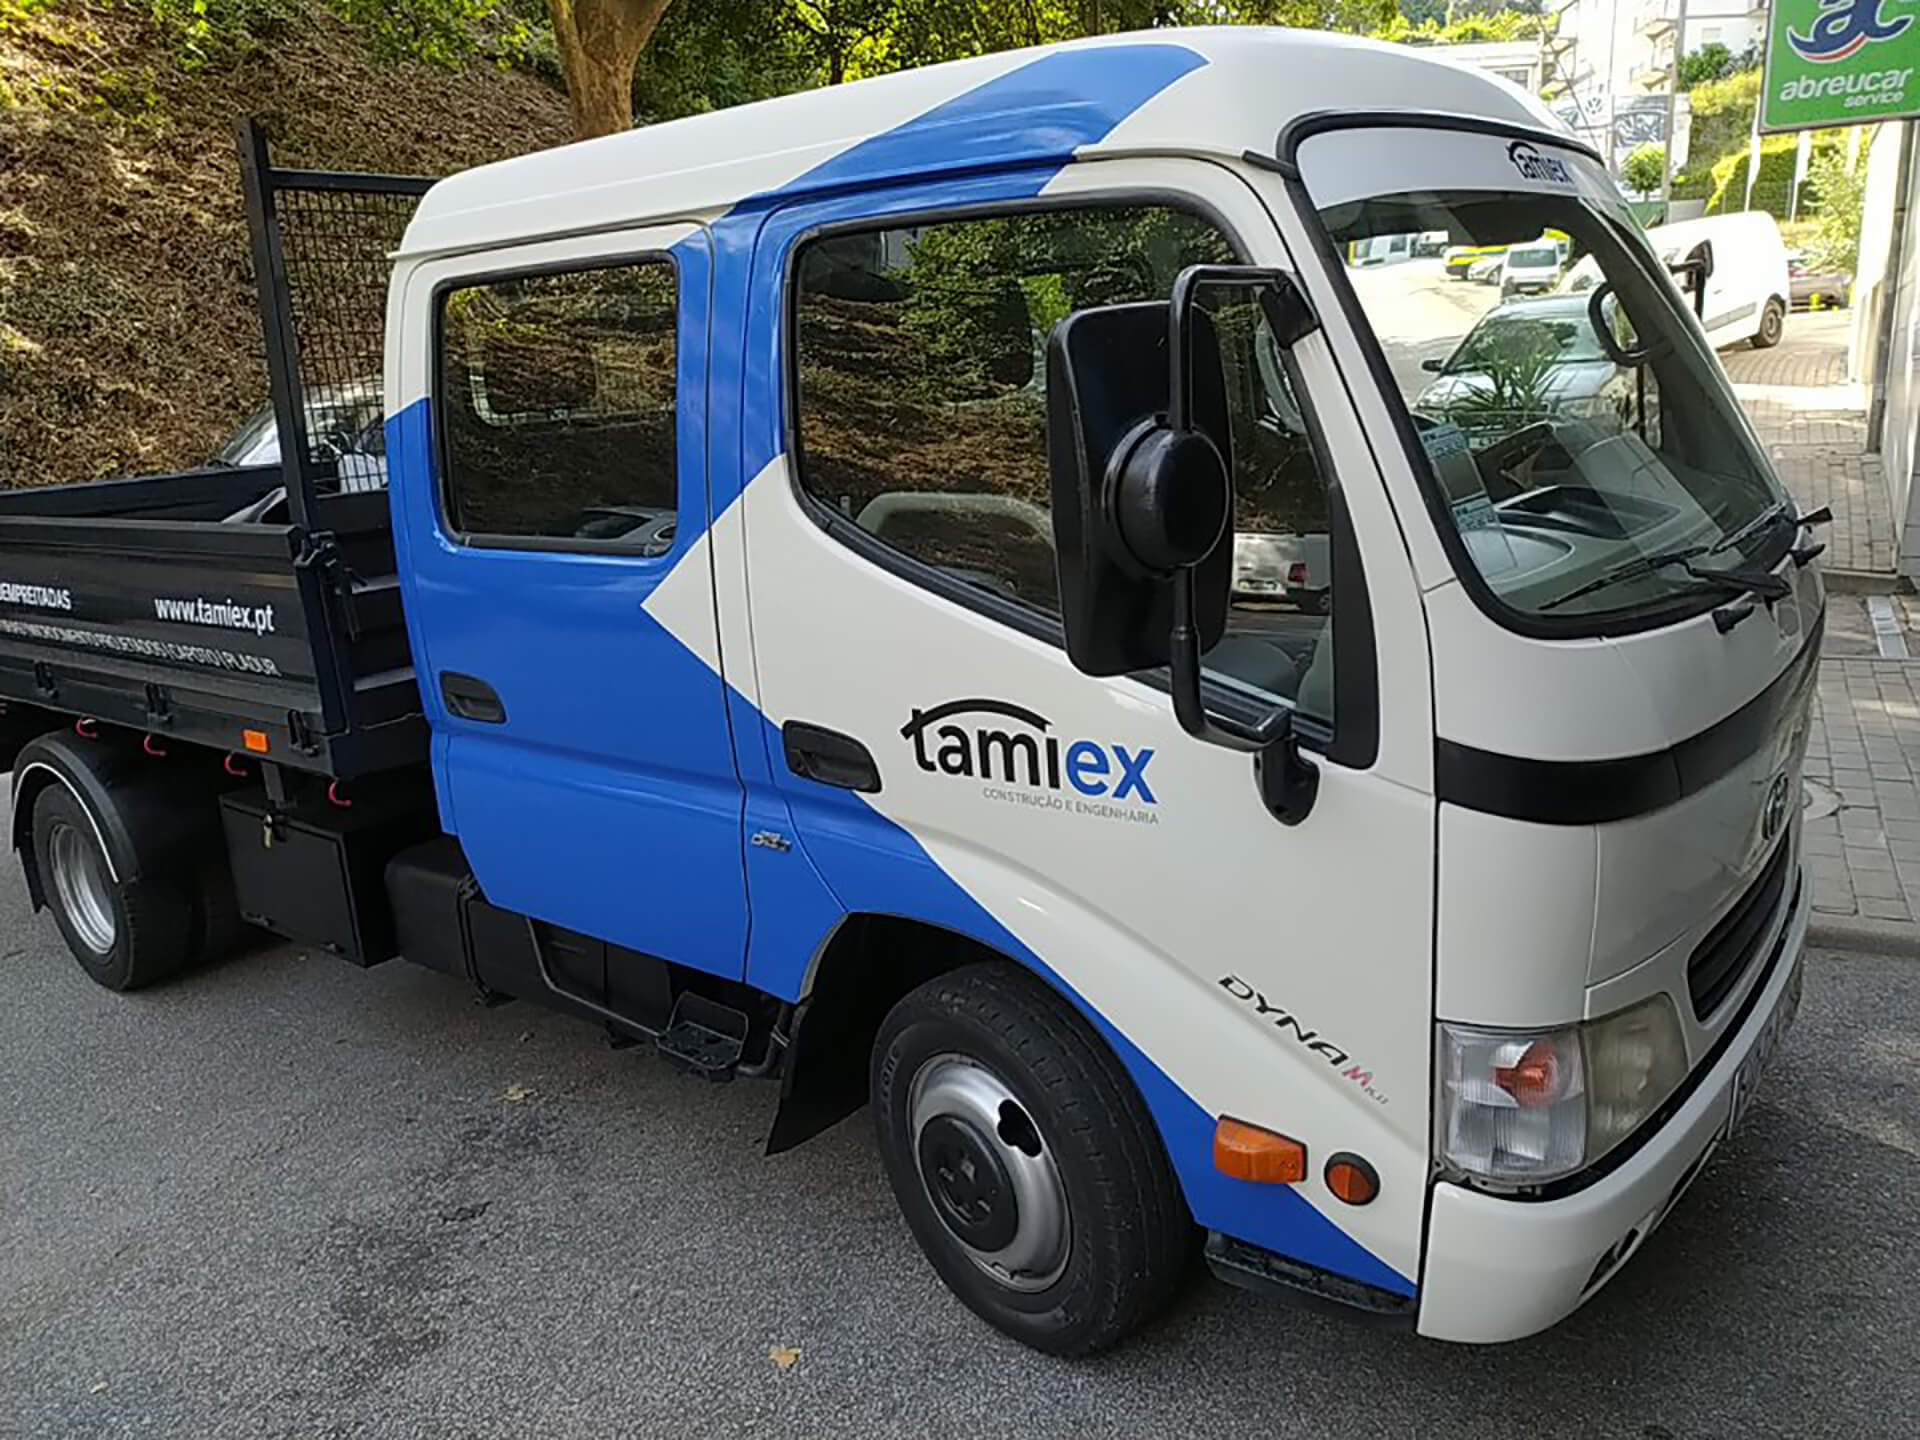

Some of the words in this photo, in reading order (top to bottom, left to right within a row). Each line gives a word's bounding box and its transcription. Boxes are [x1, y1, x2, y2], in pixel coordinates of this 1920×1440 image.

[1780, 68, 1914, 101] abreucar
[1843, 91, 1904, 108] service
[155, 598, 275, 636] www.tamiex.pt
[900, 699, 1158, 804] tamiex
[983, 787, 1063, 810] CONSTRUÇÃO
[1065, 800, 1073, 813] E
[1075, 803, 1159, 825] ENGENHARIA
[1218, 975, 1349, 1066] DYNA
